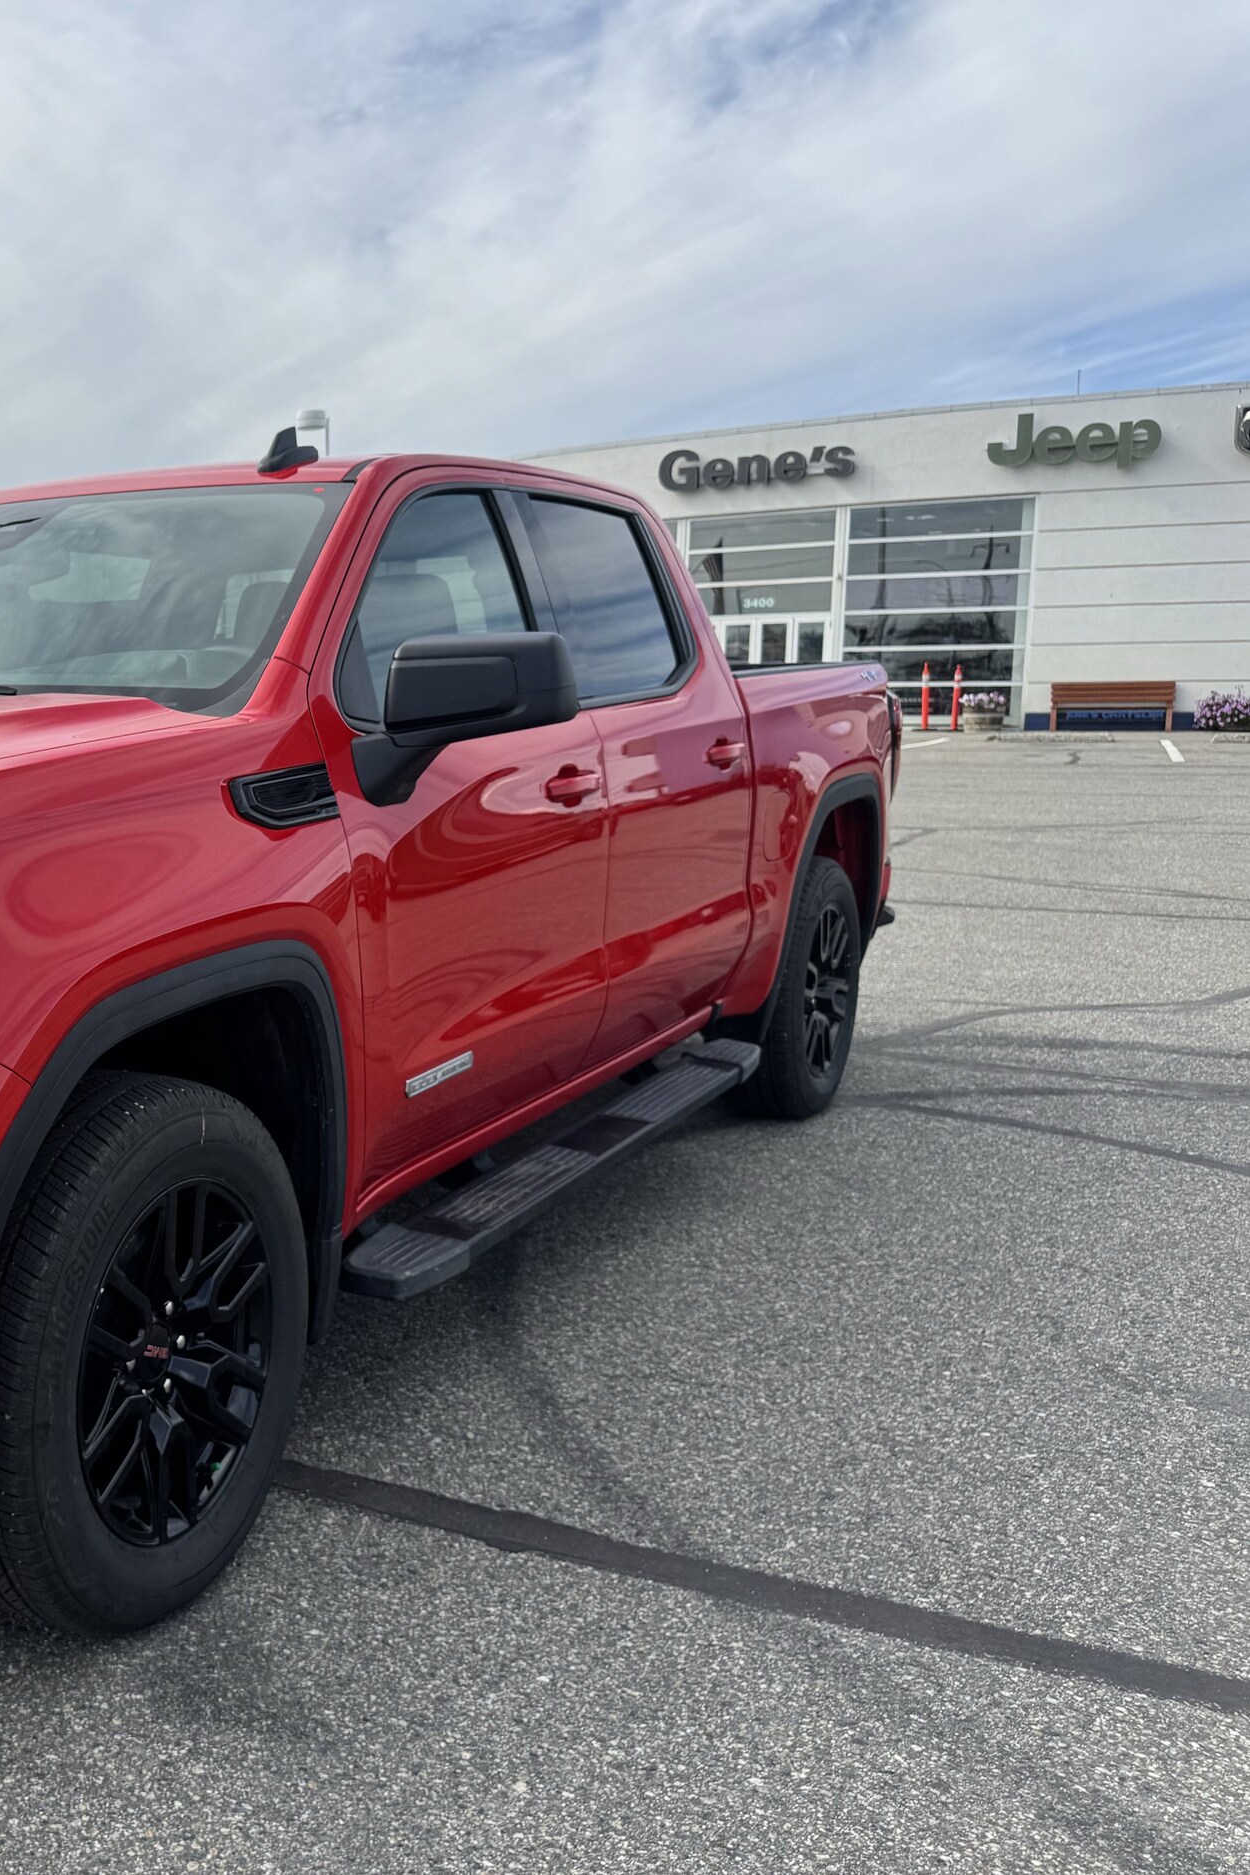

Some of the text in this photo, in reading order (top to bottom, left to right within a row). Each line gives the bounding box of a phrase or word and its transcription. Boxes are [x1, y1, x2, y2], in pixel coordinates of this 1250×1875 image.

[987, 413, 1162, 469] Jeep
[659, 445, 856, 493] Gene's
[743, 597, 775, 609] 3400
